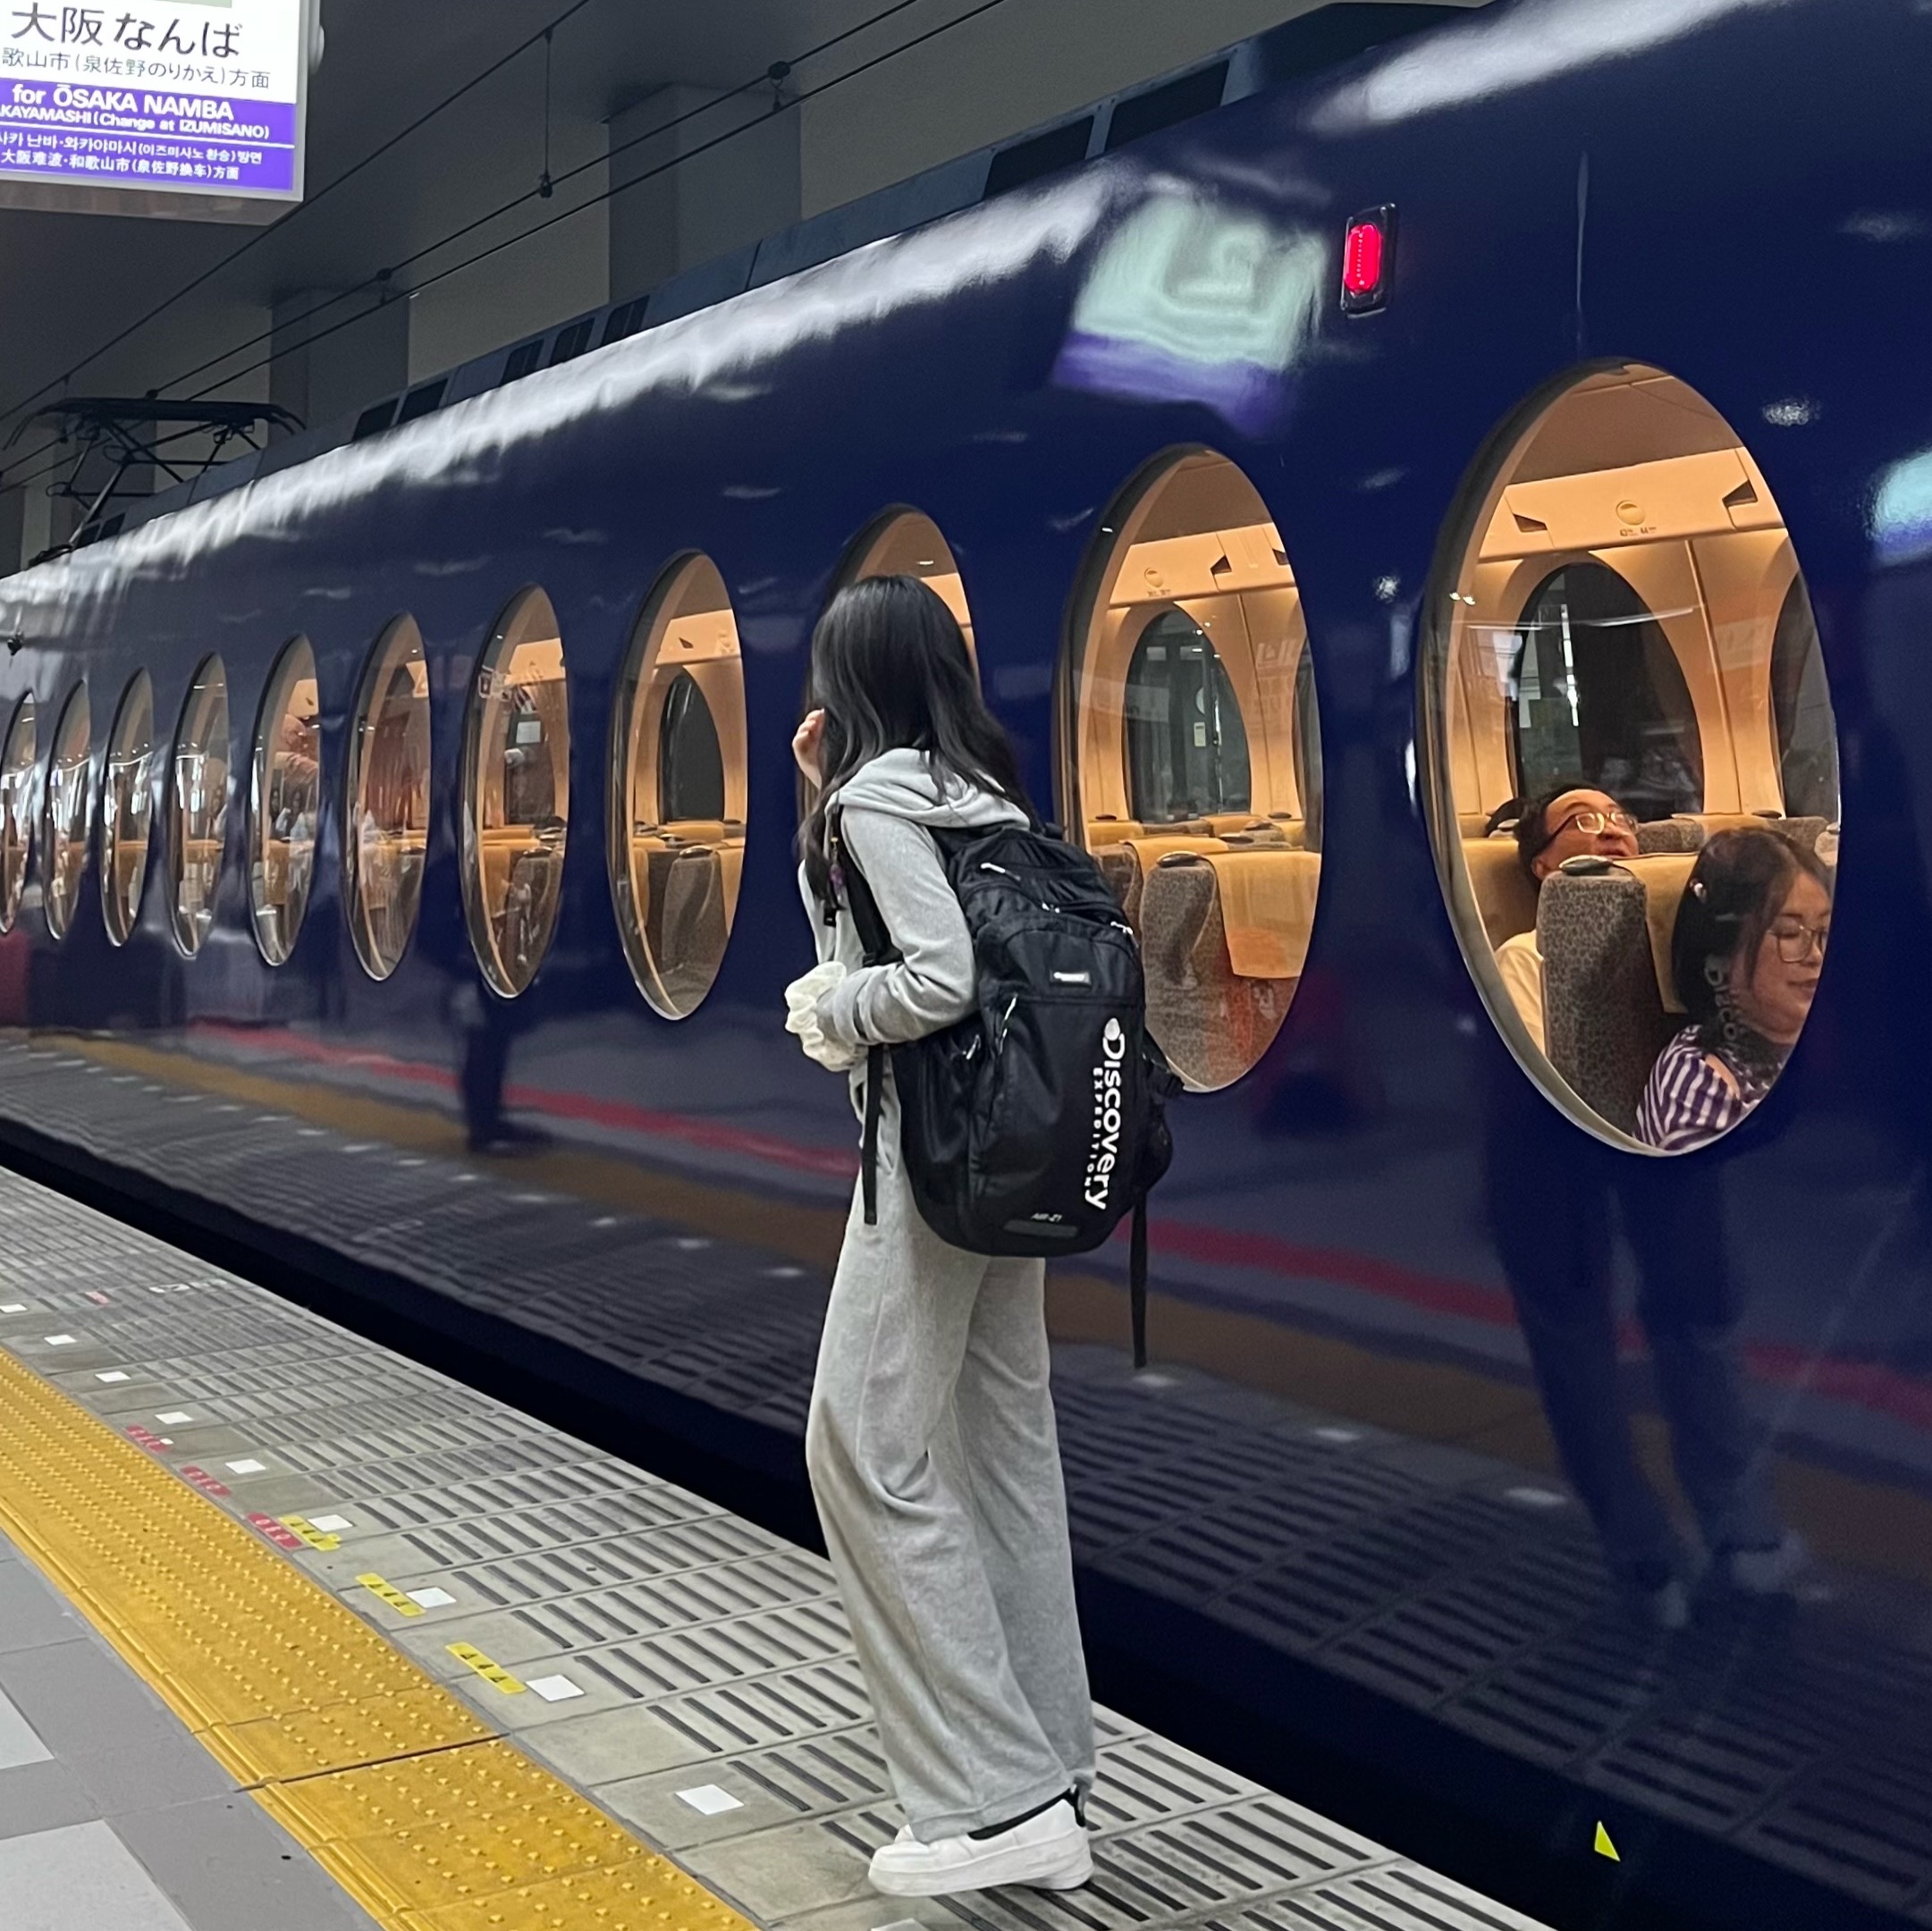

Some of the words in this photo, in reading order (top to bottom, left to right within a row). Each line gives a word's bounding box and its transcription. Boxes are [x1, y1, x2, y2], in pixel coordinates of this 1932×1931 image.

[11, 2, 243, 58] 大阪なんば
[13, 83, 46, 104] for
[53, 84, 138, 113] ŌSAKA
[144, 94, 234, 121] NAMBA
[159, 120, 175, 131] at
[180, 120, 270, 139] IZUMISANO)
[1084, 1024, 1125, 1210] Discovery
[1084, 1067, 1103, 1187] EXPEDITION
